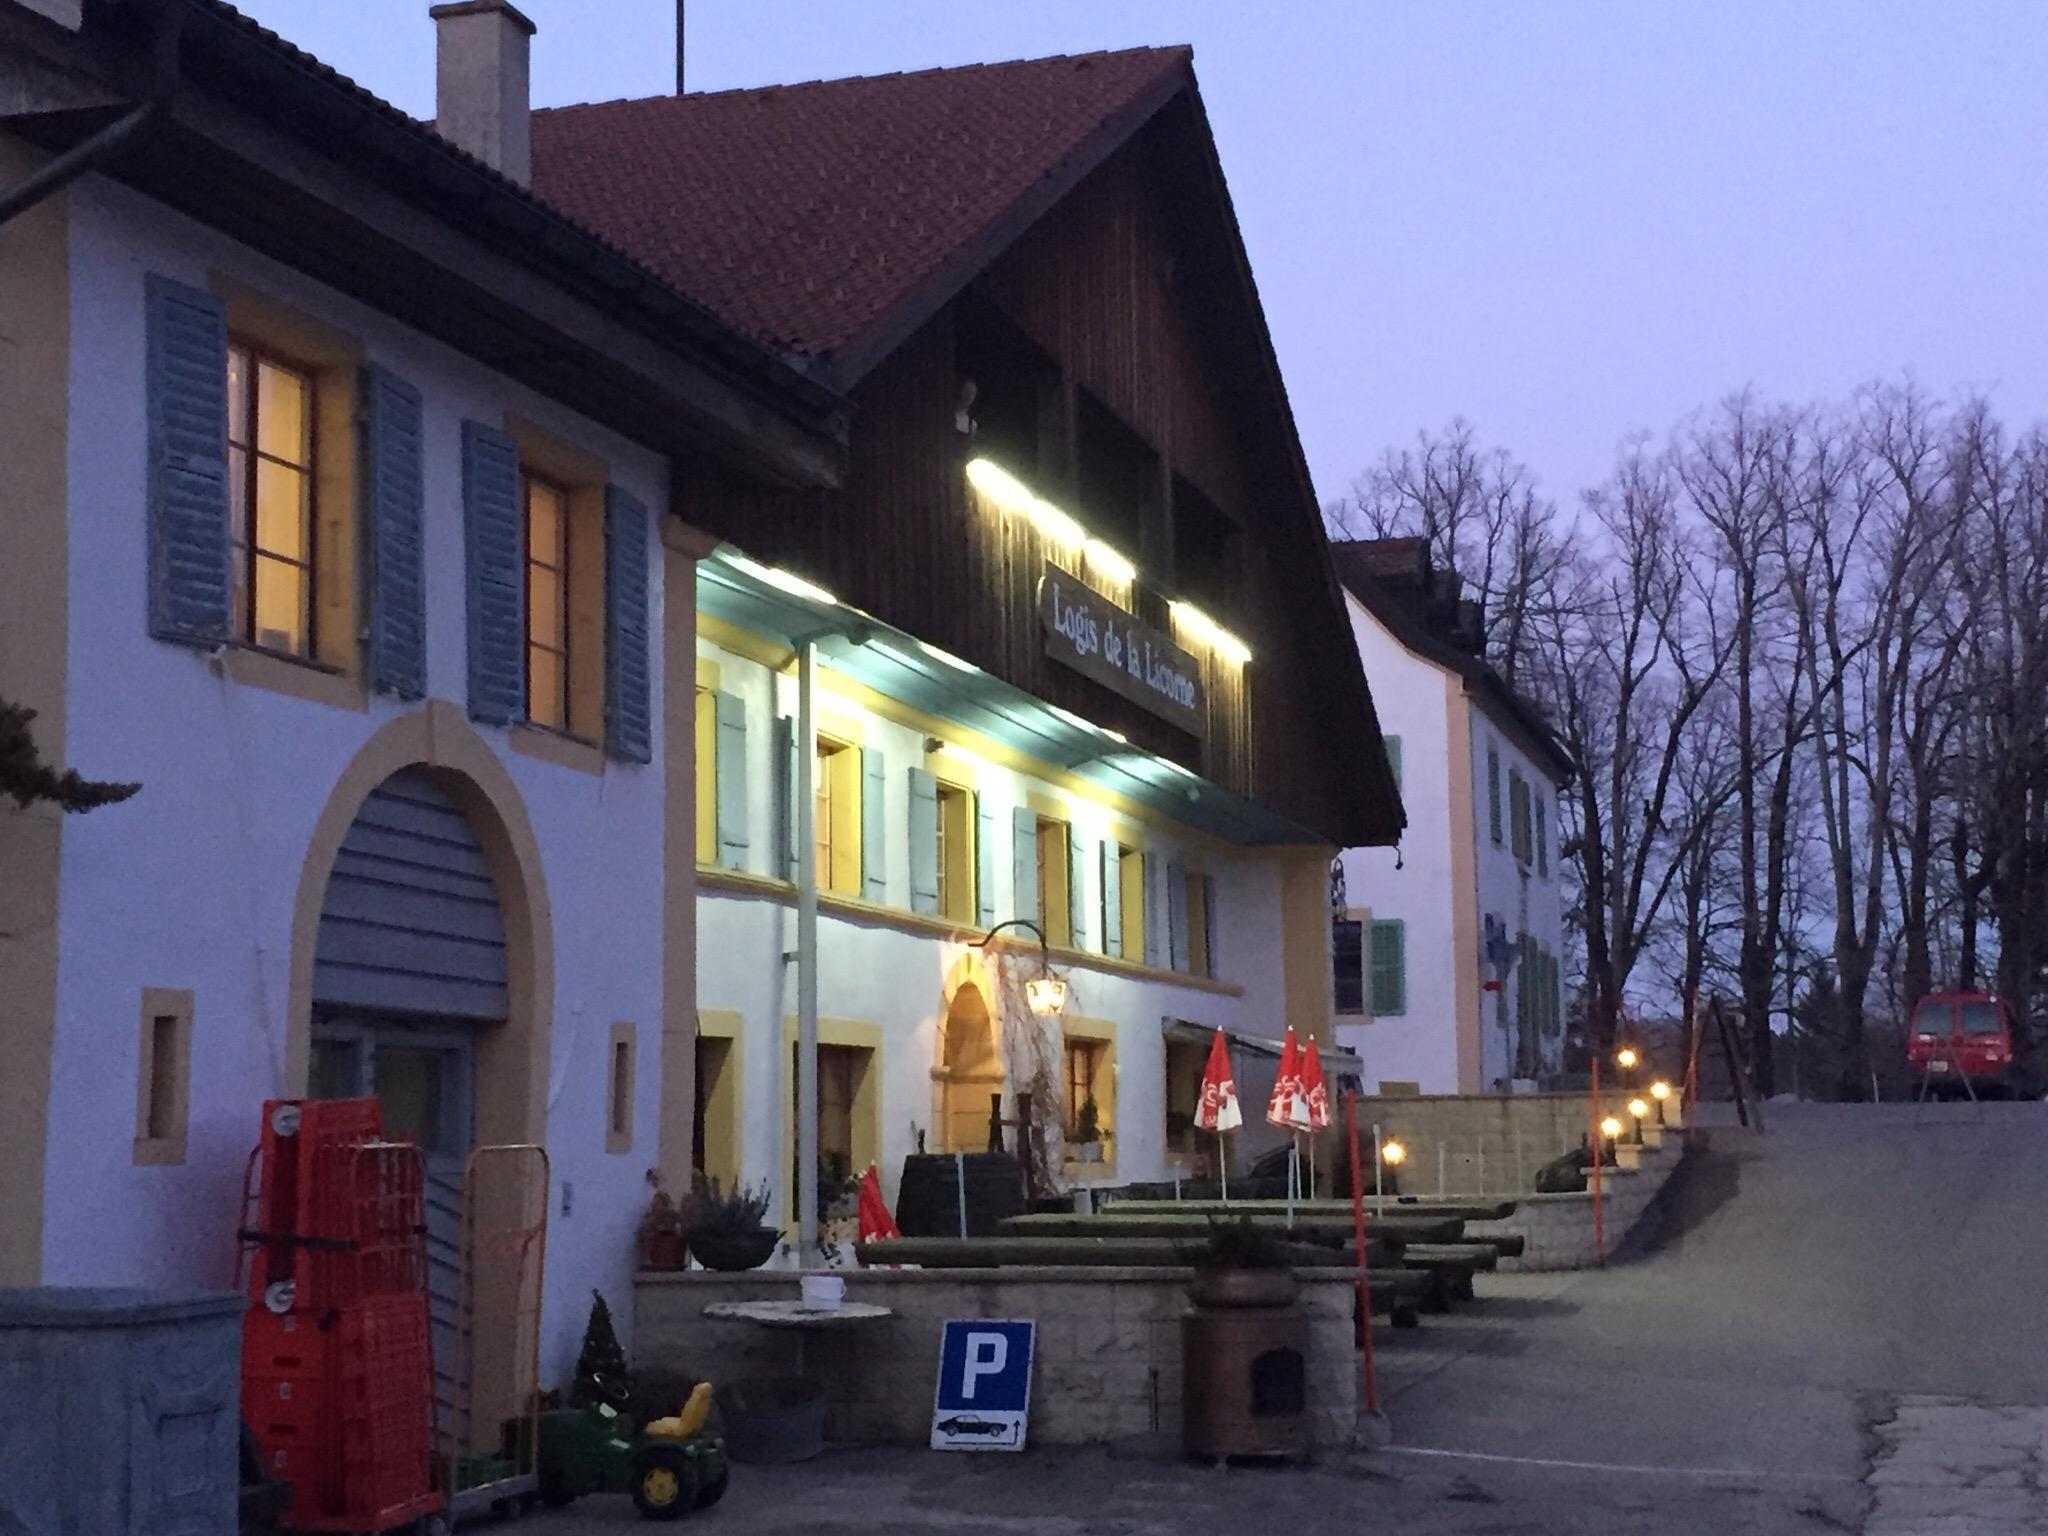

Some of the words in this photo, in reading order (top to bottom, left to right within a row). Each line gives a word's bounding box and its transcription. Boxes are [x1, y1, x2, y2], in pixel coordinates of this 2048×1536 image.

[1053, 582, 1098, 655] Logis
[1104, 619, 1122, 668] de
[1127, 629, 1142, 680] la
[1145, 641, 1196, 709] Licorne
[962, 1332, 1008, 1399] P
